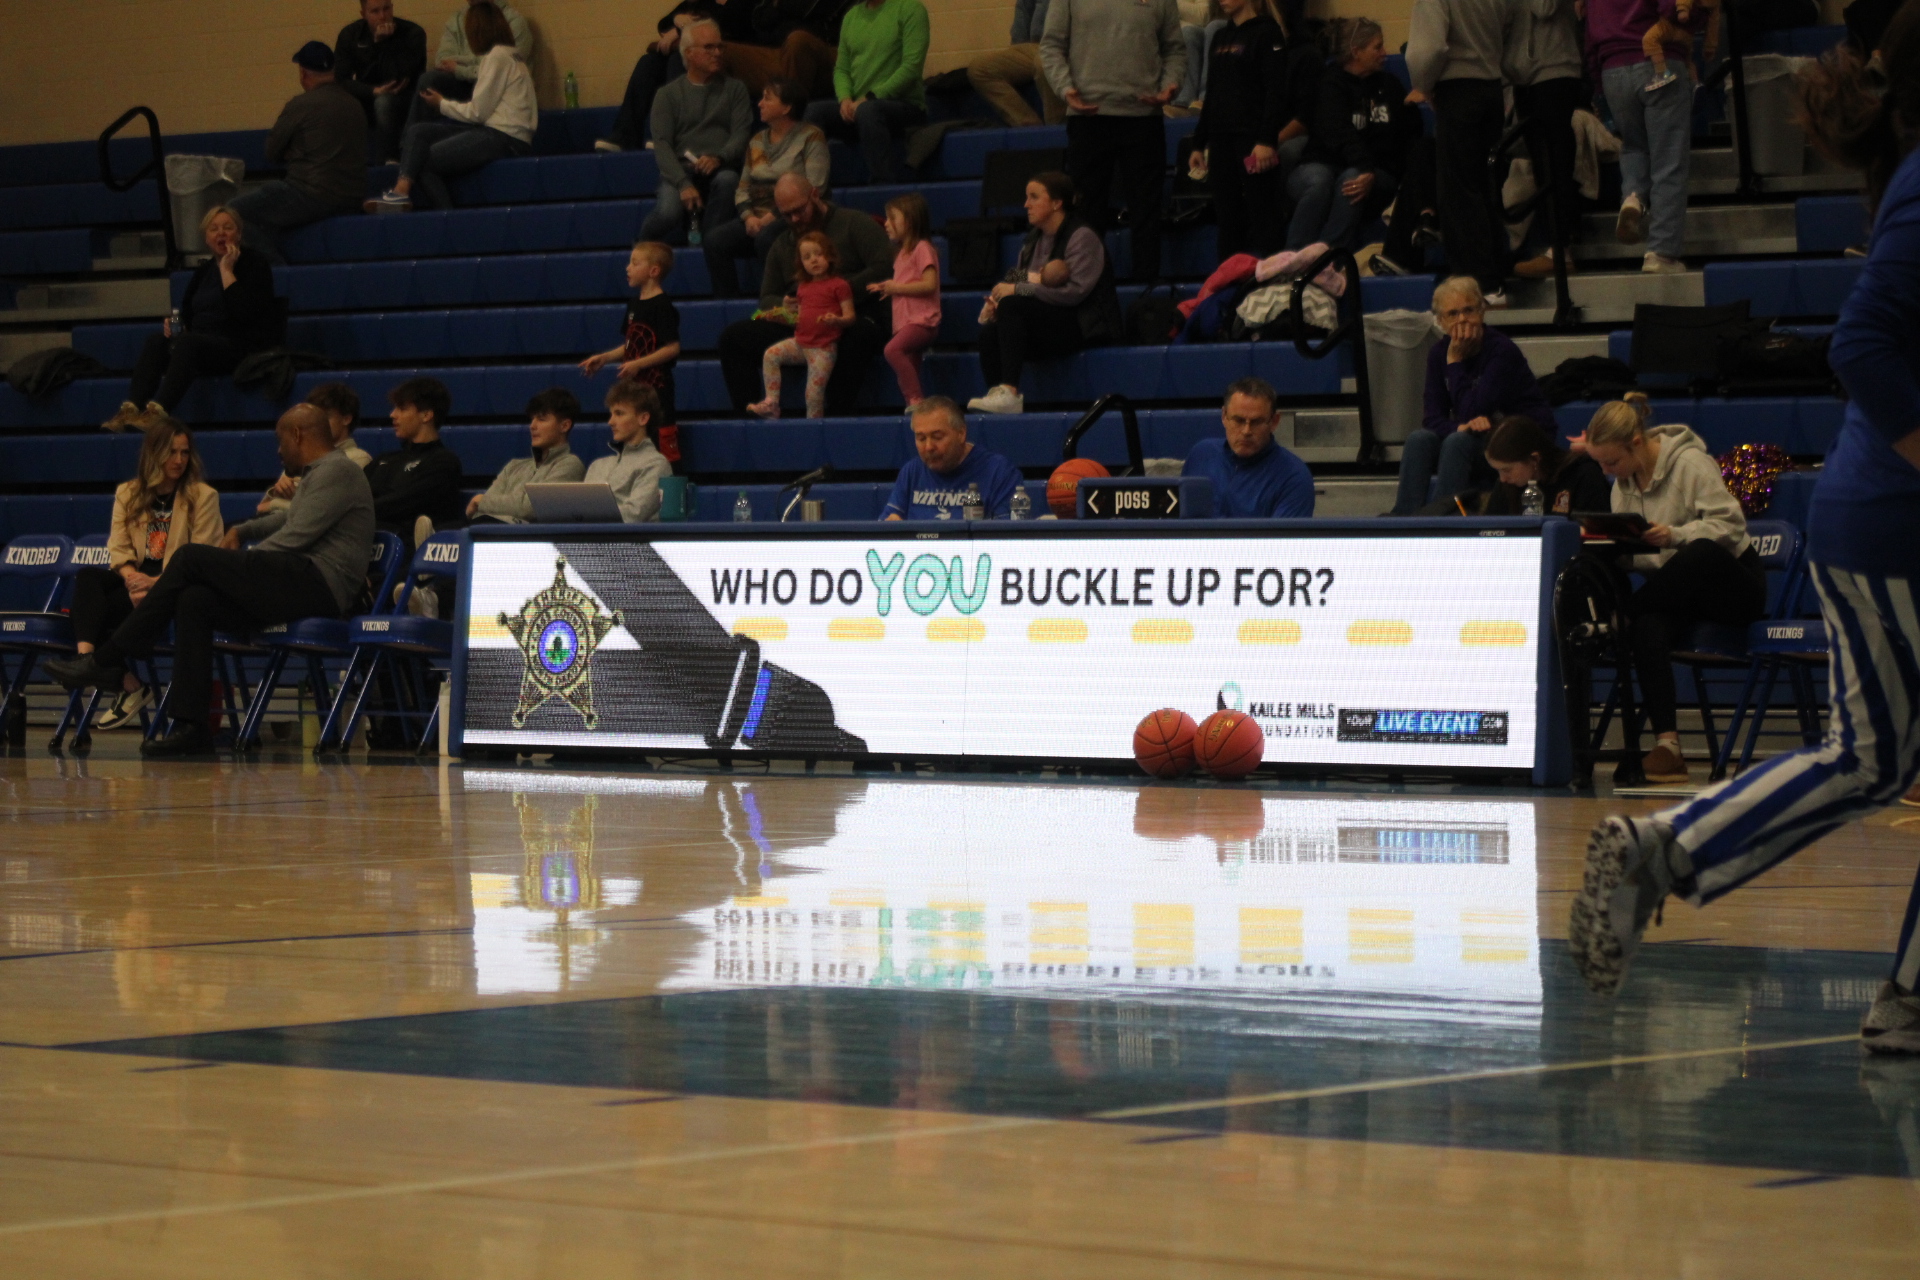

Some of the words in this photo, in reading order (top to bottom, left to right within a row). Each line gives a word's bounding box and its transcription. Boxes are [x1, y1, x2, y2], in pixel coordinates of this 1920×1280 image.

[912, 490, 969, 507] VIKING
[5, 546, 61, 565] KINDRED
[423, 543, 460, 562] KIND
[710, 568, 797, 605] WHO
[809, 568, 863, 606] DO
[865, 548, 991, 617] YOU
[1000, 567, 1155, 606] BUCKLE
[1167, 568, 1221, 606] UP
[1234, 568, 1335, 607] FOR?
[3, 621, 26, 632] VIKINGS
[361, 621, 390, 632] VIKINGS
[1766, 627, 1804, 639] VIKINGS
[1249, 702, 1292, 719] KAILEE
[1296, 702, 1336, 720] MILLS
[1377, 711, 1416, 732] LIVE
[1419, 712, 1479, 734] EVENT
[1263, 724, 1335, 740] UNDATION
